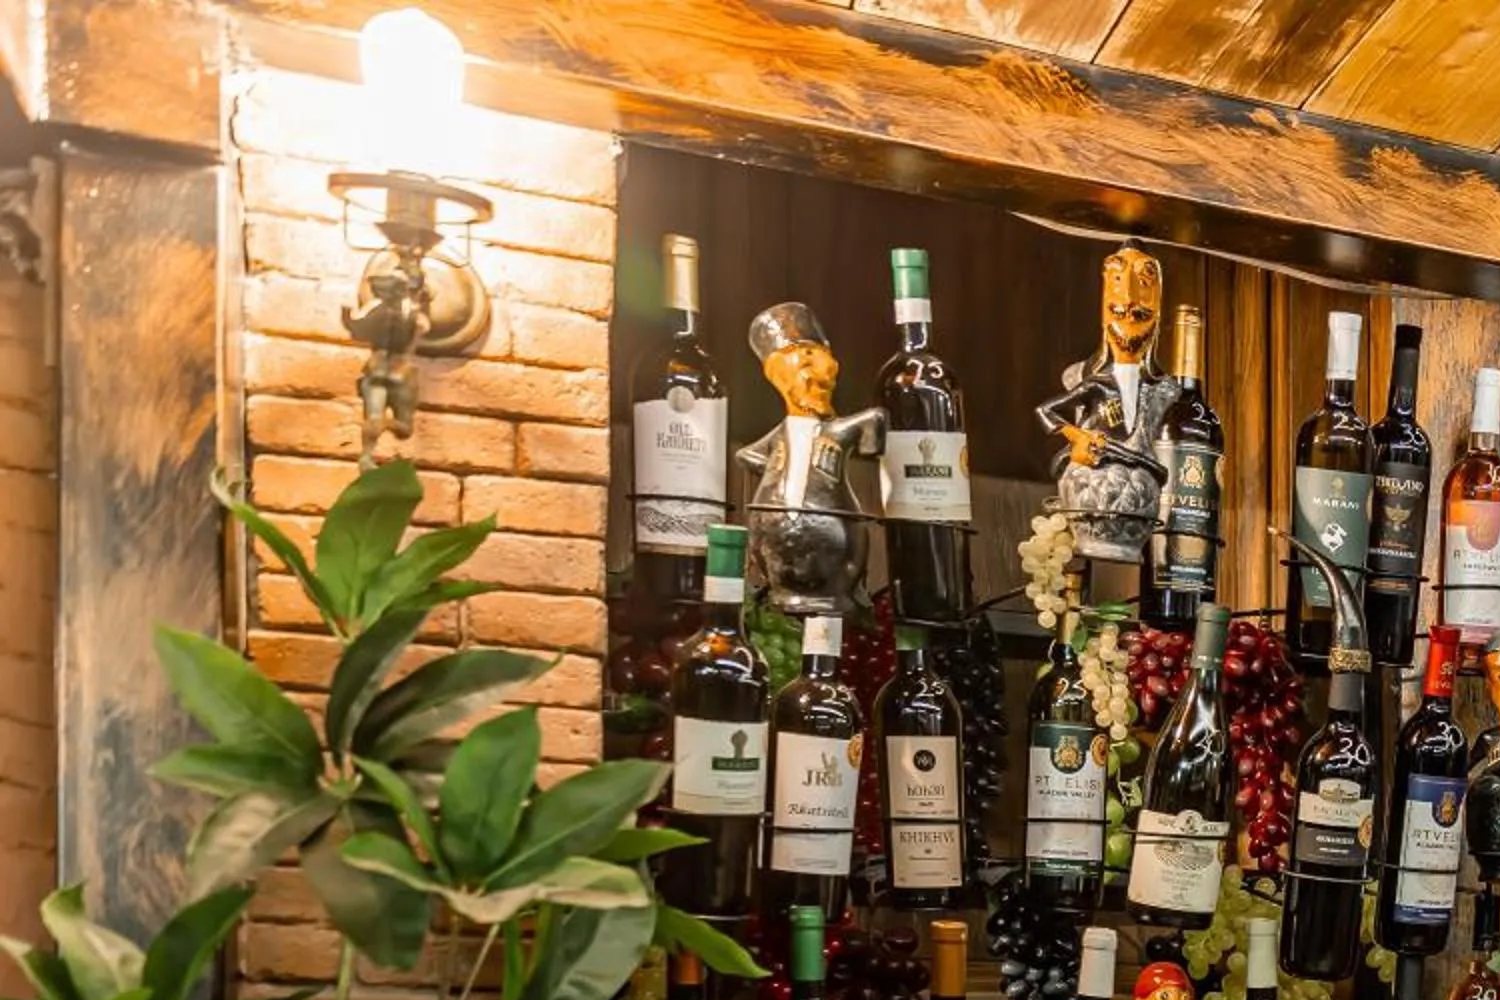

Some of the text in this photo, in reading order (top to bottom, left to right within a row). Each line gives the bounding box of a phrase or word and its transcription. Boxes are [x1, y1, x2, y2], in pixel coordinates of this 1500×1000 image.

[906, 359, 944, 385] 25
[916, 680, 945, 698] 25
[1057, 677, 1087, 701] 25
